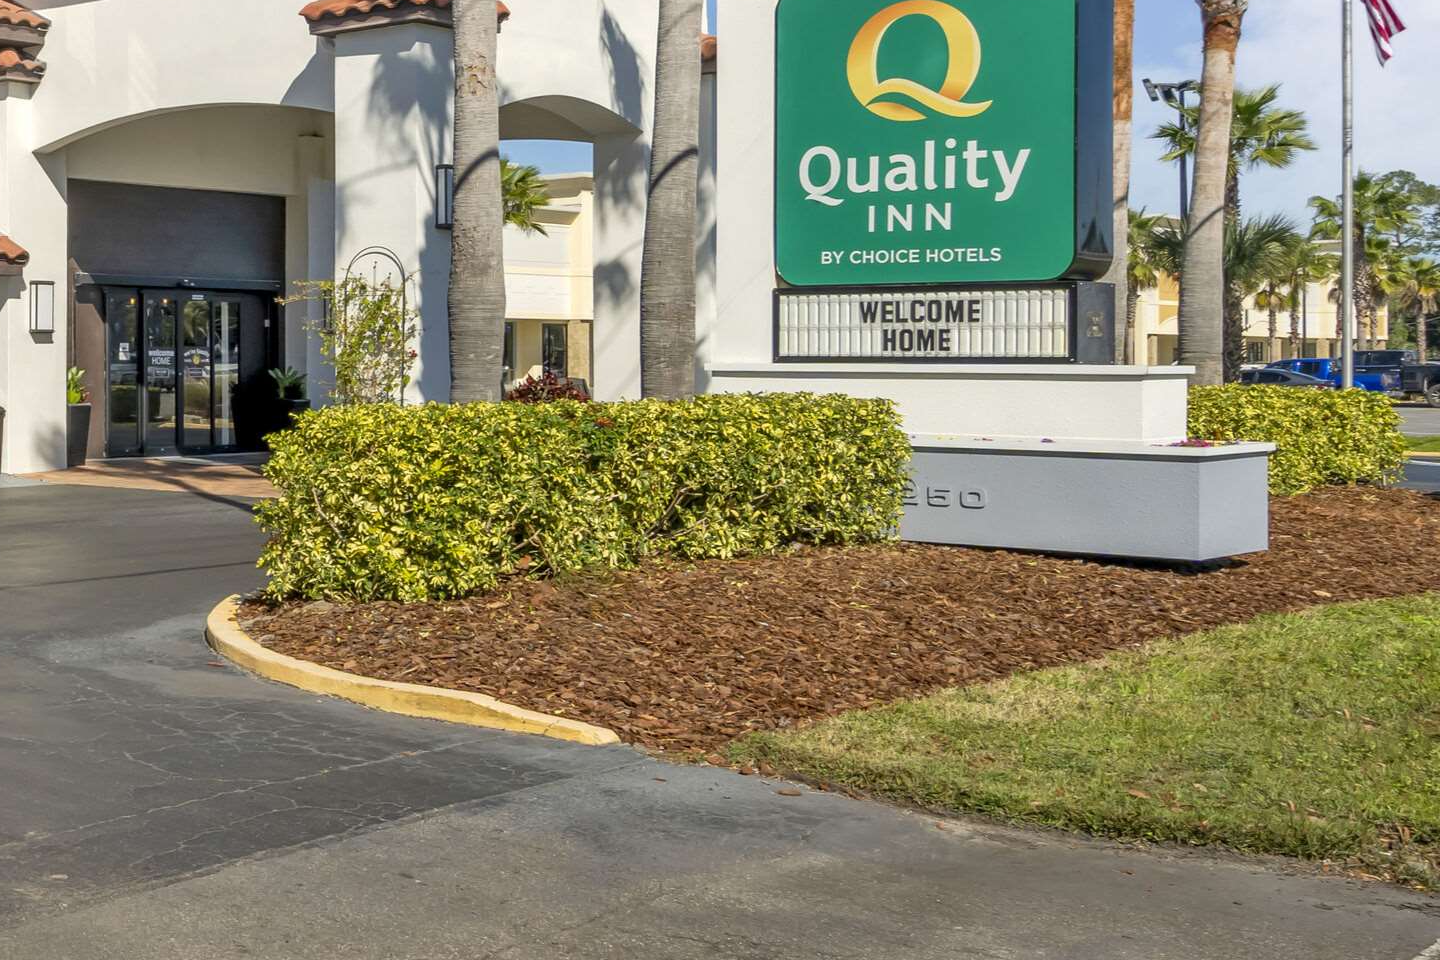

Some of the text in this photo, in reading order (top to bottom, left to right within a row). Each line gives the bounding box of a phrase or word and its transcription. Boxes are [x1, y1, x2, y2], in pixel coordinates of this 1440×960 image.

[846, 0, 993, 122] Q
[798, 137, 1031, 206] Quality
[867, 202, 953, 233] INN
[820, 246, 1003, 265] BY CHOICE HOTELS
[859, 299, 981, 324] WELCOME
[882, 328, 951, 352] HOME
